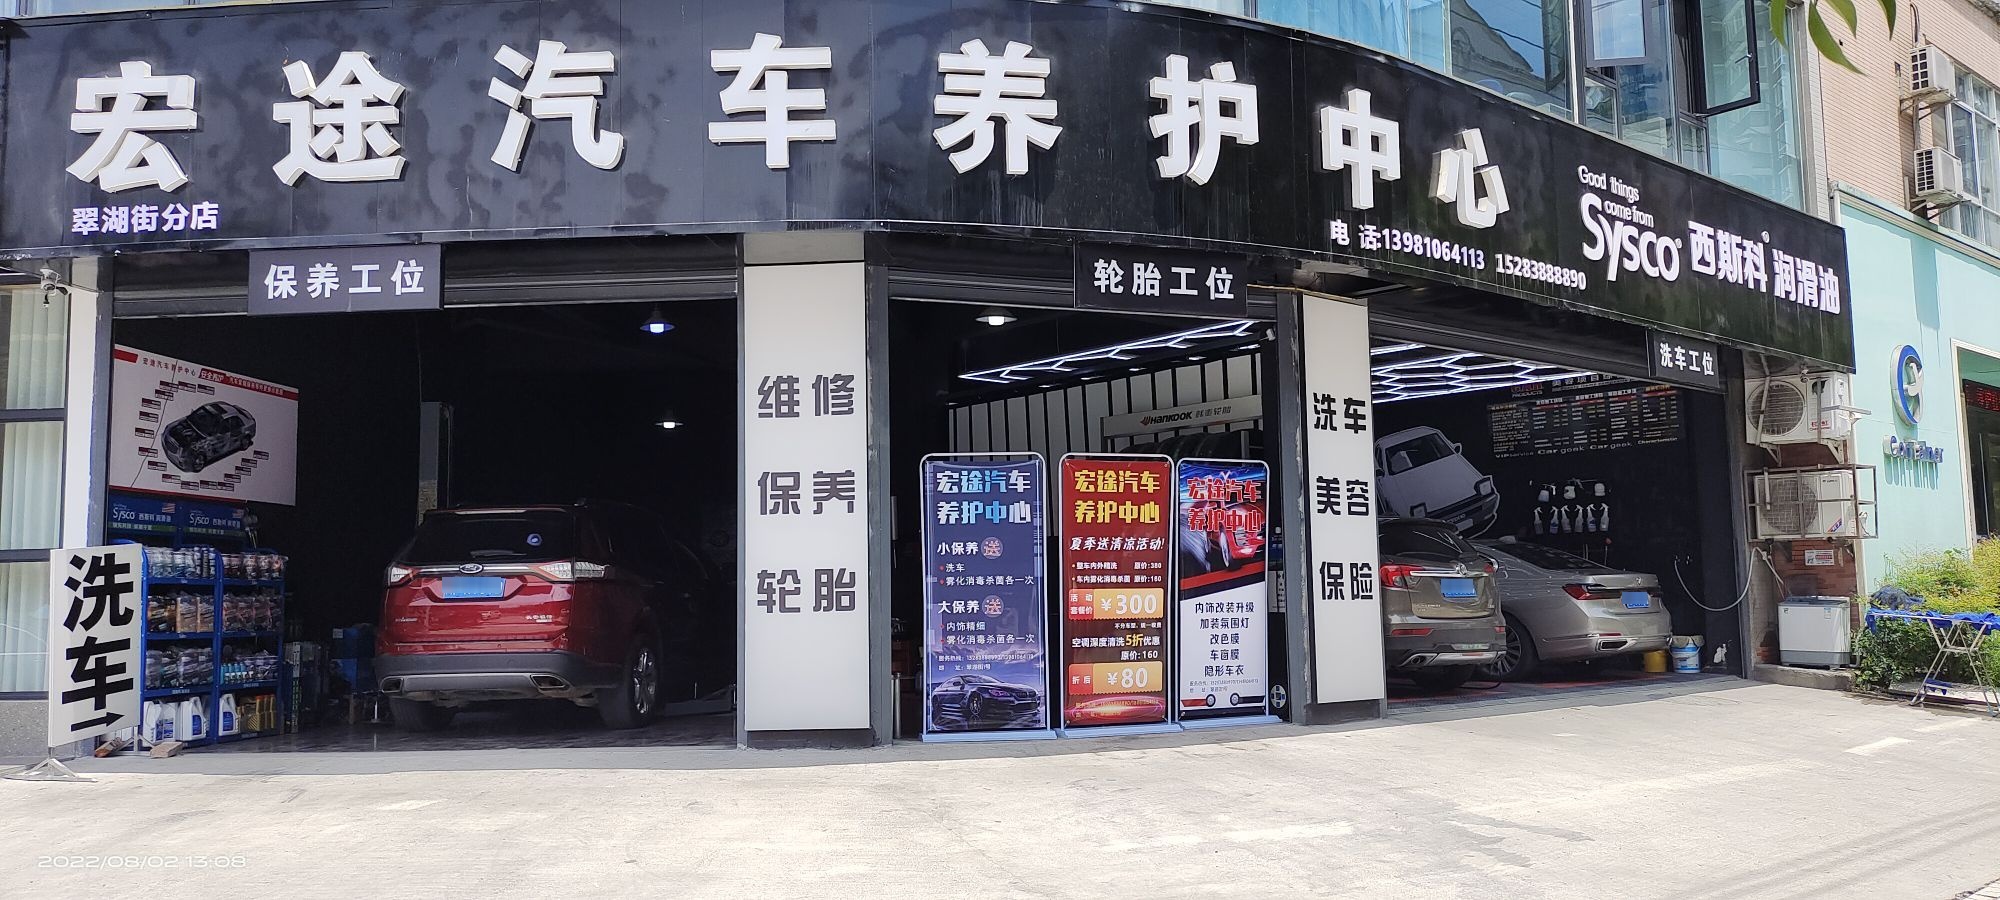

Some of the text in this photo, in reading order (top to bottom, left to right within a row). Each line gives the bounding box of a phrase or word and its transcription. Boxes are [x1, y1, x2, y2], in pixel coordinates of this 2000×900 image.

[66, 33, 1511, 229] 宏途汽车养护中心
[1577, 165, 1640, 203] Good things
[71, 201, 219, 236] 翠湖街分店
[1603, 199, 1655, 228] come from
[264, 259, 425, 300] 保养工位
[1093, 258, 1235, 301] 轮胎工位
[1495, 253, 1587, 291] 15283888890
[1688, 221, 1841, 315] 西斯科 润滑油
[1659, 342, 1715, 376] 洗车工位
[757, 373, 855, 418] 维修
[1312, 392, 1367, 434] 洗车
[757, 469, 856, 516] 保养
[936, 470, 1032, 494] 宏途汽车
[1074, 469, 1161, 494] 宏途汽车
[1186, 476, 1262, 503] 宏途汽车
[1316, 475, 1369, 517] 美容
[936, 501, 1032, 525] 养护中心
[1074, 500, 1161, 524] 养护中心
[1187, 507, 1262, 532] 养护中心
[937, 540, 1001, 557] 小保养 送
[1070, 536, 1165, 551] 夏季送清凉活动!
[945, 563, 965, 573] 洗车
[945, 575, 1035, 587] 雾化消毒杀菌各一次
[1319, 561, 1374, 601] 保险
[757, 567, 856, 614] 轮胎
[938, 598, 1002, 615] 大保养 送
[1195, 601, 1255, 614] 内饰改装升级
[62, 552, 134, 711] 洗车
[946, 621, 986, 632] 内饰精细
[1199, 617, 1250, 630] 加装氛围灯
[946, 634, 1035, 645] 雾化消毒杀菌各一次
[1209, 633, 1240, 645] 改色膜
[1209, 649, 1240, 661] 车窗膜
[1204, 664, 1244, 678] 隐形车衣
